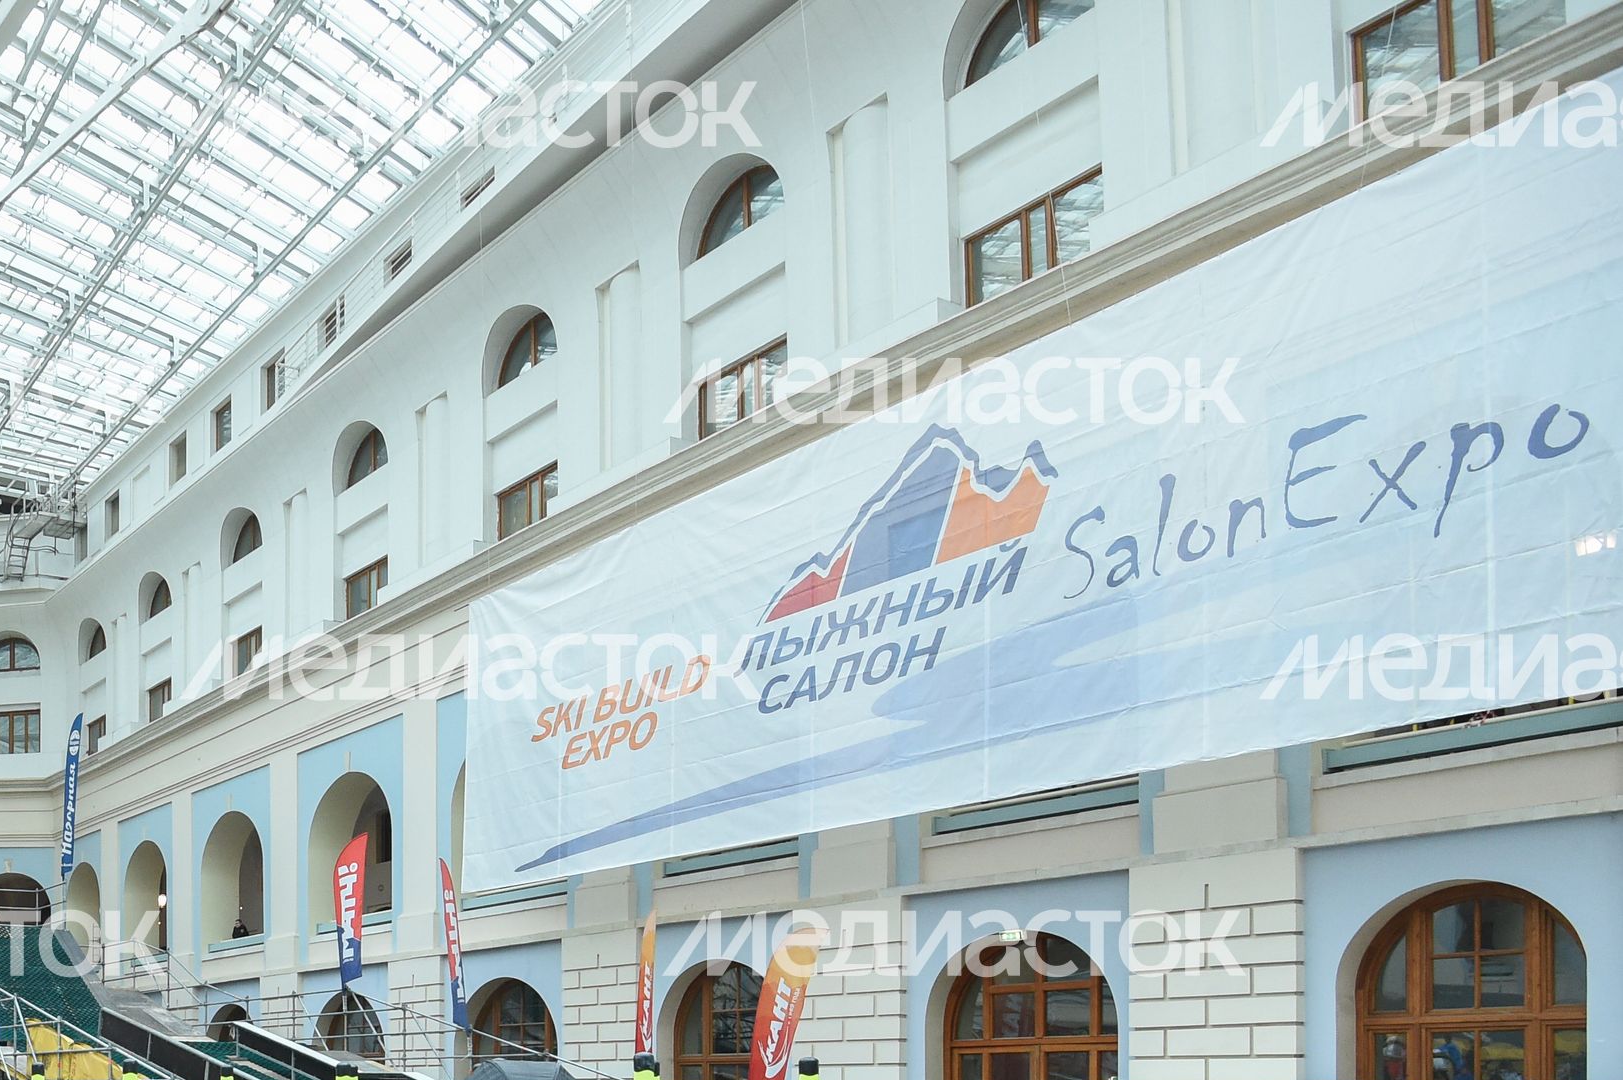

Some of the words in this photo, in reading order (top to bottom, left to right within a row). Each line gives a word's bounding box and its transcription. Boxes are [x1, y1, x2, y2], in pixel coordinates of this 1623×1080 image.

[733, 542, 1030, 678] ЛЫЖНЫЙ
[531, 697, 586, 743] SKI
[592, 654, 711, 724] BUILD
[757, 626, 947, 715] САЛОН
[561, 712, 659, 770] EXPO
[62, 762, 76, 857] Нагорная
[338, 862, 358, 961] МАТЧ!
[765, 976, 792, 1065] КАНТ
